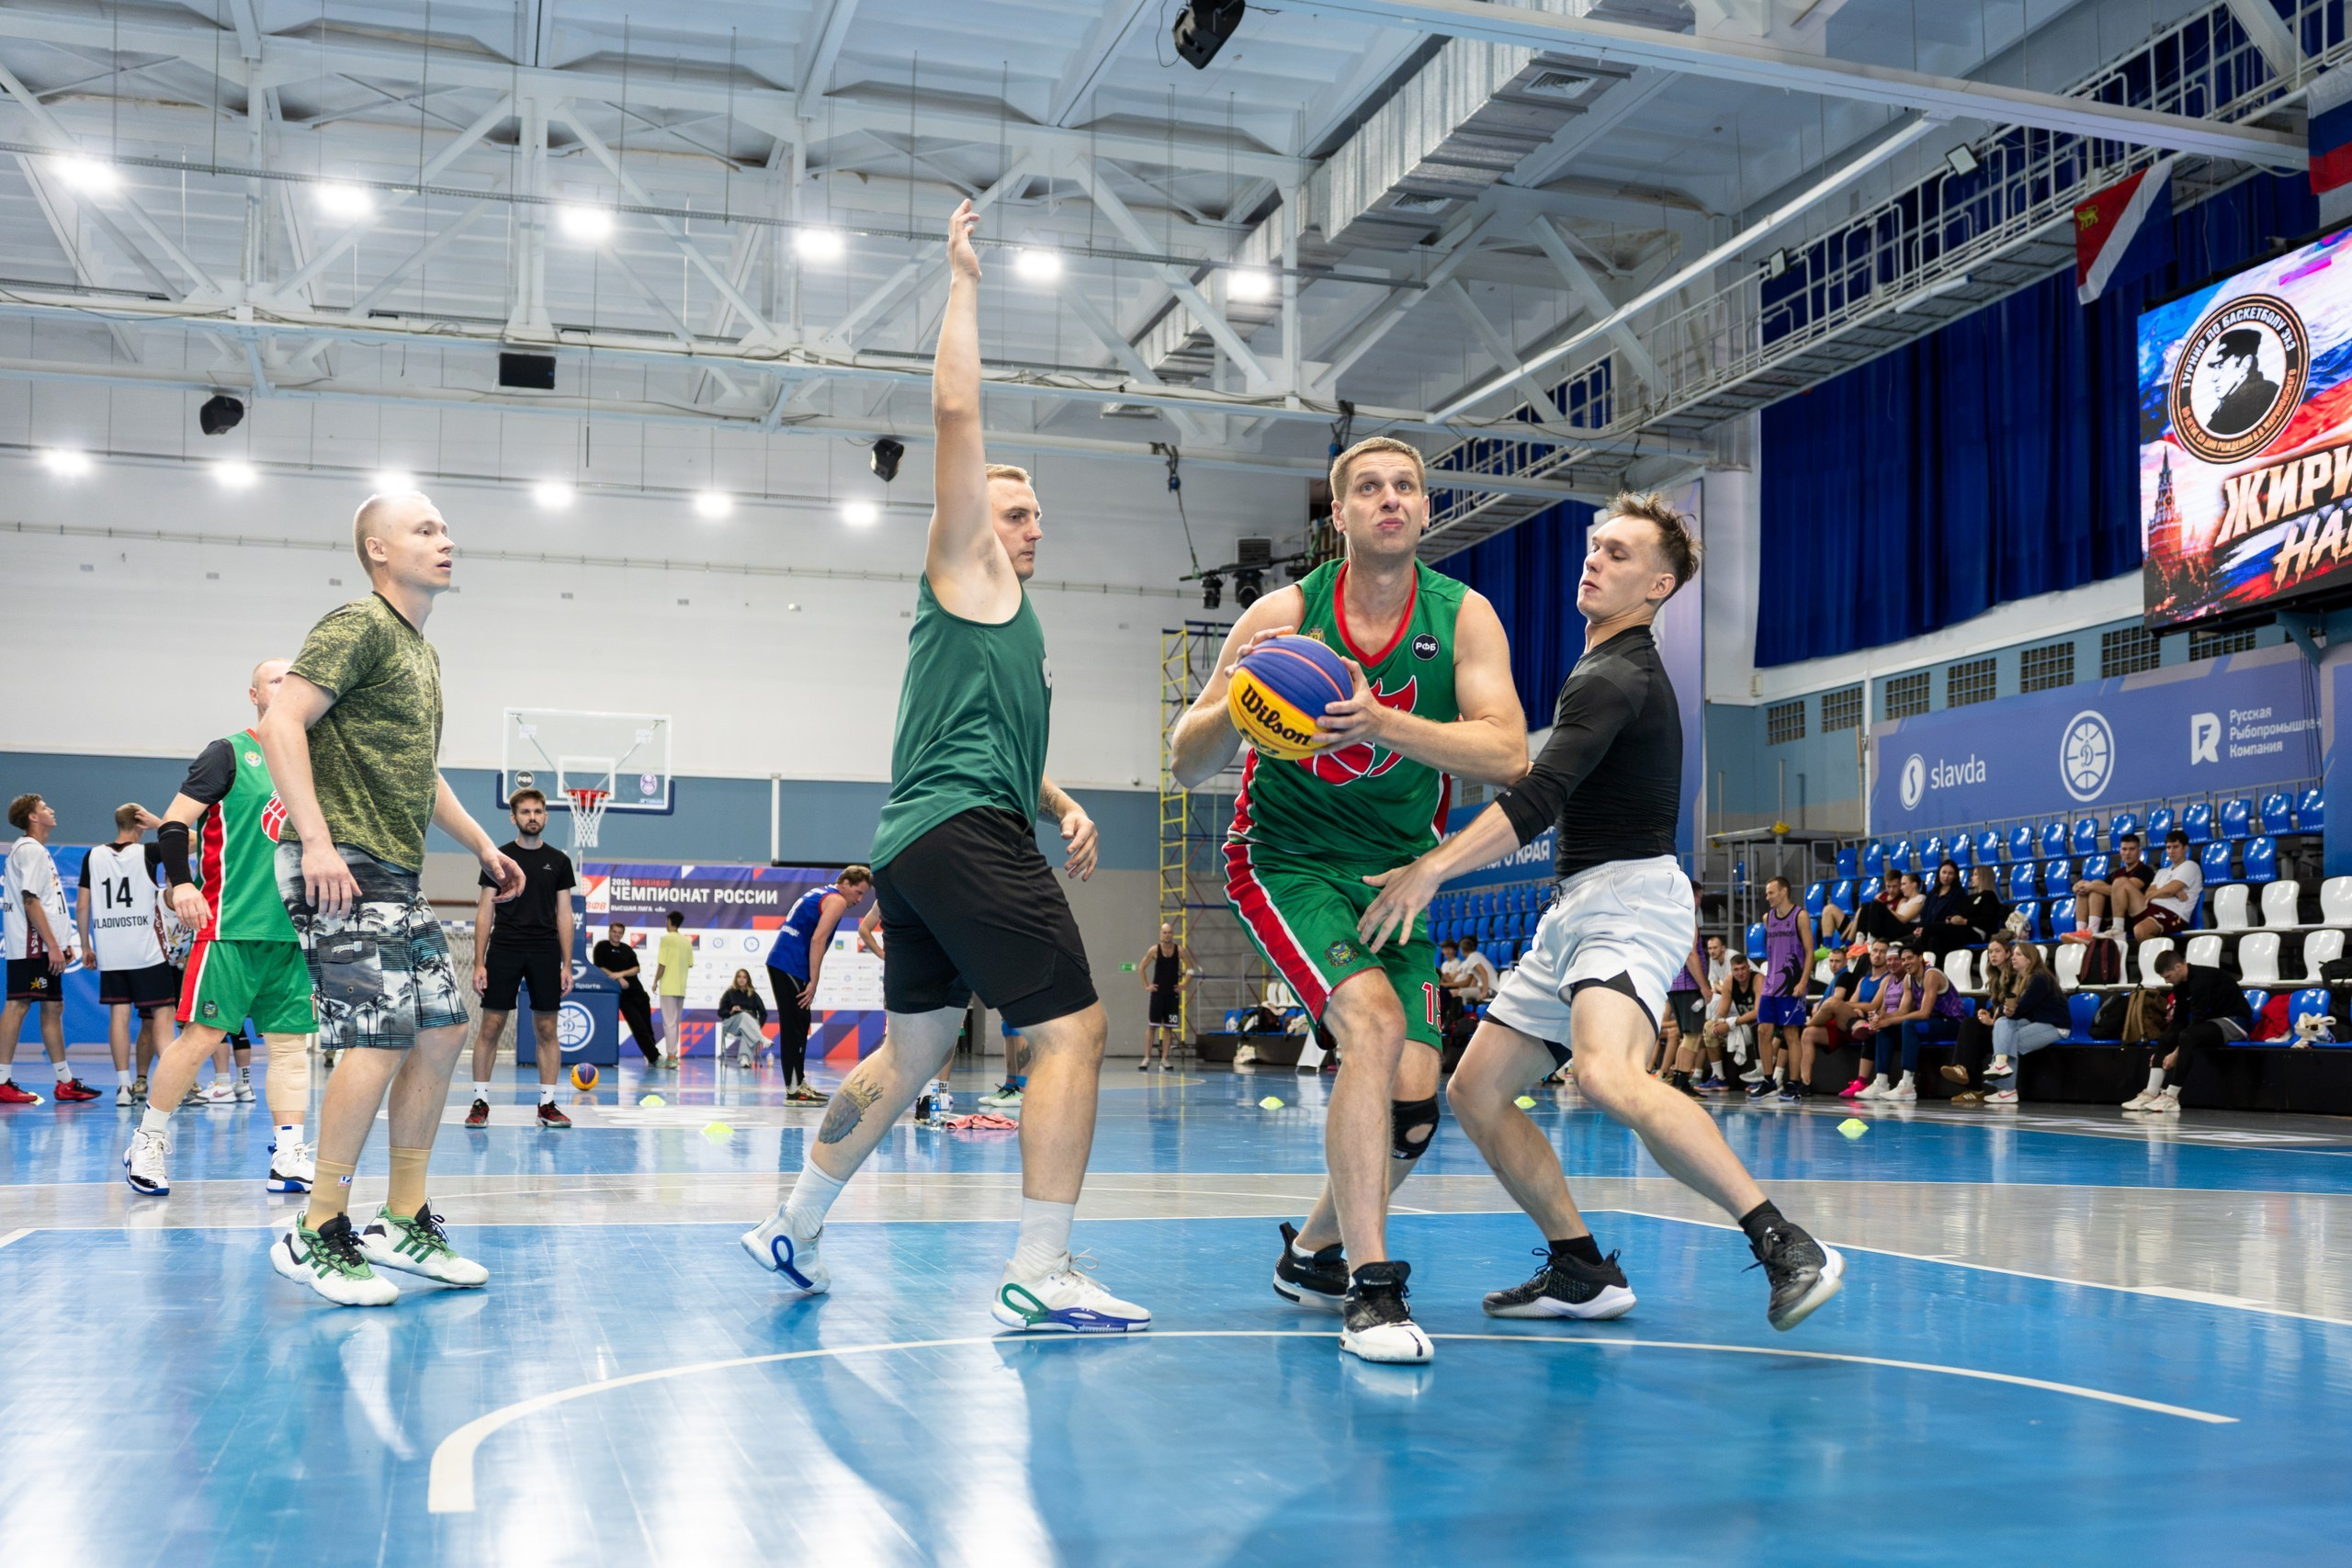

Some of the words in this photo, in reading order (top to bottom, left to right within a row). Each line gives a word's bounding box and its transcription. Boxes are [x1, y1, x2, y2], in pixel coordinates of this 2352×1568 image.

[2182, 340, 2207, 389] ТУРНИР
[2206, 323, 2221, 341] ПО
[2222, 307, 2287, 332] БАСКЕТБОЛУ
[1415, 642, 1436, 651] РФБ
[1240, 683, 1311, 746] Wilson
[2230, 707, 2272, 726] Русская
[2230, 740, 2283, 759] Компания
[1930, 753, 1986, 789] slavda
[1516, 840, 1550, 865] КРАЯ
[102, 876, 133, 908] 14
[610, 886, 710, 903] ЧЕМПИОНАТ
[714, 889, 777, 904] РОССИИ
